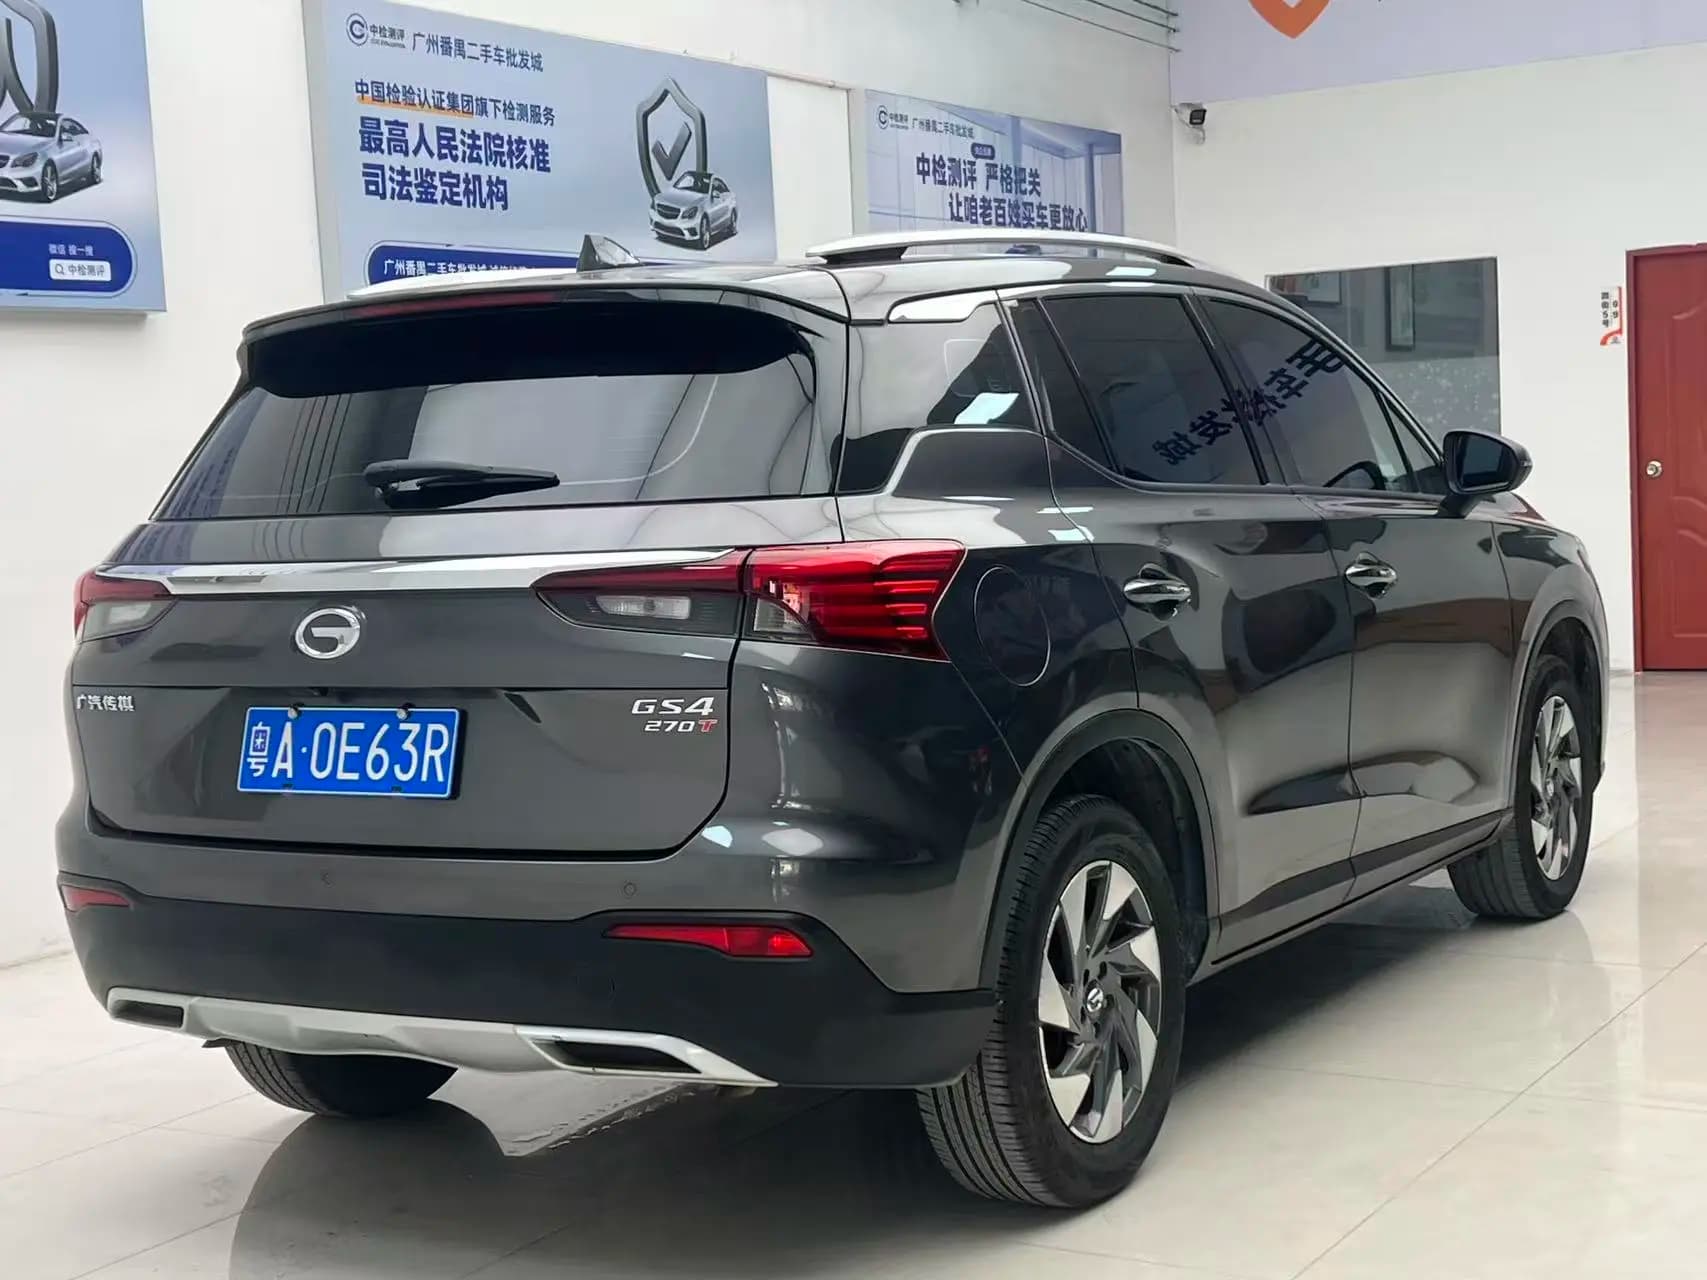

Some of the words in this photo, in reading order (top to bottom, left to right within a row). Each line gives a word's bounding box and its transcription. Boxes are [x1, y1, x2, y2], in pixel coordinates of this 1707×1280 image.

[369, 24, 405, 41] 中检测评
[412, 32, 543, 72] 广州番禺二手车批发城
[355, 78, 556, 127] 中国检验认证集团旗下检测服务
[359, 116, 551, 173] 最高人民法院核准
[362, 162, 509, 211] 司法鉴定机构
[916, 152, 977, 191] 中检测评
[985, 162, 1041, 197] 严格把关
[949, 192, 1088, 232] 让咱老百姓买车更放心
[76, 694, 135, 712] 广汽传祺
[631, 696, 715, 716] GS4
[644, 719, 718, 733] 270T
